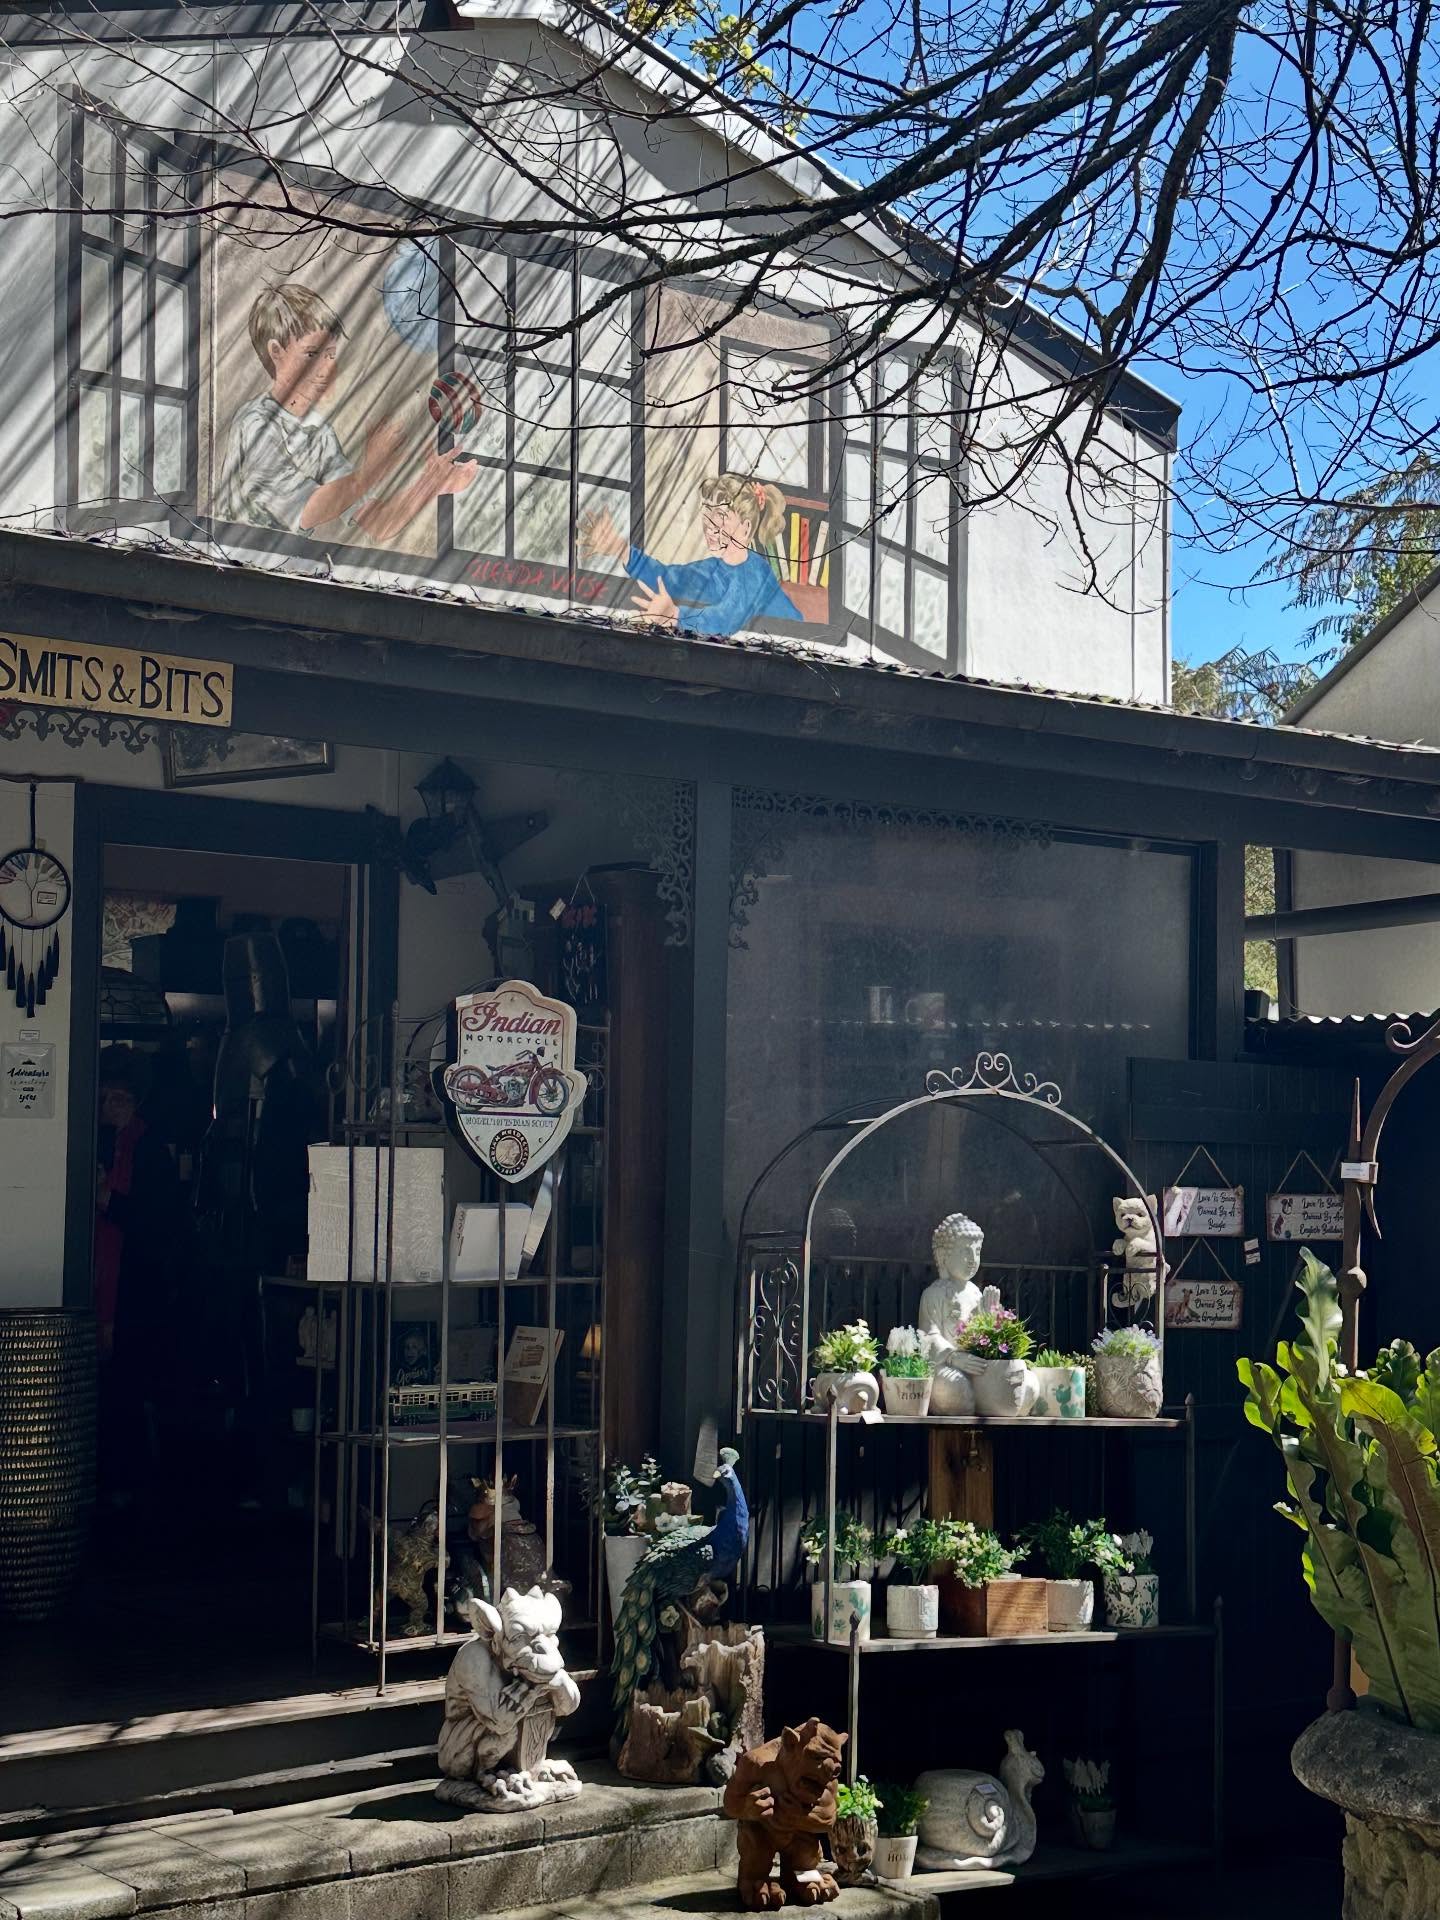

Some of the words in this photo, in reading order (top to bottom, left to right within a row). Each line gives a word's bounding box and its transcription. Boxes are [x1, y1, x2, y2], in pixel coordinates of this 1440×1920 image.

[552, 568, 608, 598] WISE
[139, 656, 225, 718] BITS
[462, 1001, 561, 1035] Indian
[466, 1034, 558, 1046] MOTORCYCLE
